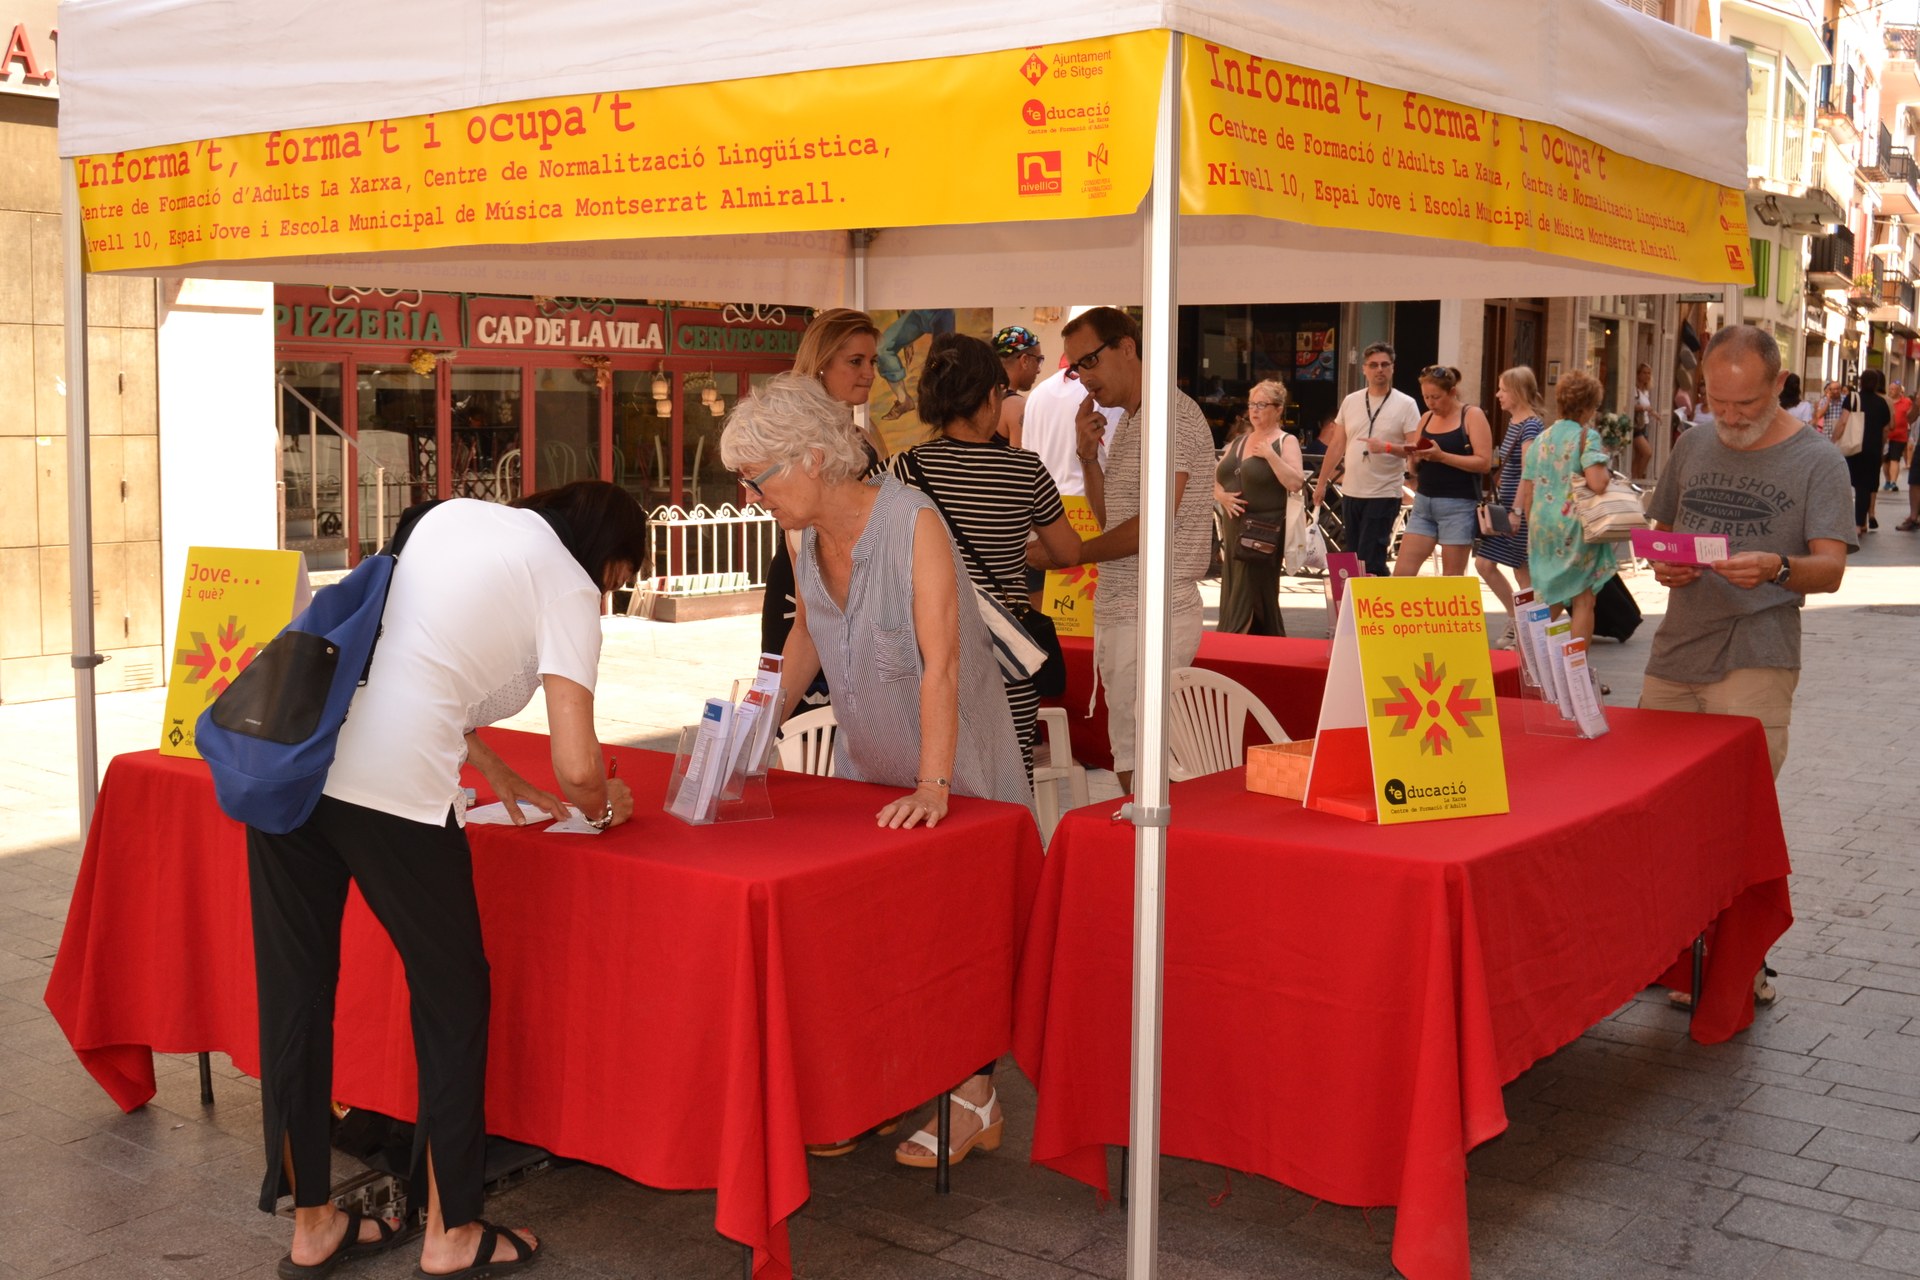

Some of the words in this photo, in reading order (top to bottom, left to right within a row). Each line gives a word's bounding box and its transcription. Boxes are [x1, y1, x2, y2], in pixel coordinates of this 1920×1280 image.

[1053, 50, 1112, 67] Ajuntament
[1053, 67, 1067, 79] de
[1070, 65, 1103, 79] Sitges
[1205, 44, 1382, 132] Informa't,
[1403, 92, 1499, 147] forma't
[1519, 118, 1528, 152] i
[1541, 133, 1606, 181] ocupa't
[79, 140, 238, 188] Informa't,
[265, 120, 400, 166] forma't
[423, 113, 442, 149] i
[467, 93, 635, 150] ocupa't
[1209, 112, 1267, 146] Centre
[1276, 127, 1295, 150] de
[1303, 132, 1374, 164] Formació
[1382, 146, 1445, 175] d'Adults
[1452, 159, 1469, 178] La
[1521, 171, 1553, 197] Centre
[1557, 182, 1568, 202] de
[81, 202, 123, 221] entre
[131, 198, 149, 215] de
[232, 181, 310, 204] d'Adults
[320, 180, 339, 197] La
[350, 175, 411, 194] Xarxa,
[424, 166, 487, 188] Centre
[501, 160, 528, 181] de
[539, 145, 705, 178] Normalització
[718, 134, 890, 169] Lingüística,
[134, 231, 158, 250] 10,
[169, 225, 202, 248] Espai
[210, 223, 250, 239] Jove
[260, 220, 269, 237] i
[280, 215, 339, 236] Escola
[349, 206, 444, 232] Municipal
[455, 204, 475, 223] de
[485, 200, 563, 221] Música
[575, 191, 707, 217] Montserrat
[720, 181, 846, 209] Almirall.
[1208, 162, 1274, 192] Nivell
[1280, 172, 1305, 203] 10,
[1314, 179, 1359, 209] Espai
[1367, 187, 1401, 211] Jove
[1409, 192, 1417, 212] i
[1424, 195, 1470, 219] Escola
[1538, 213, 1550, 232] de
[1554, 217, 1585, 241] Música
[1588, 226, 1637, 253] Montserrat
[274, 304, 445, 342] PIZZERIA
[478, 315, 533, 344] CAP
[534, 317, 566, 346] DE
[569, 319, 605, 348] LA
[606, 320, 663, 350] VILA
[678, 324, 803, 354] CERVECERI
[1736, 476, 1796, 513] SHORE
[1736, 495, 1759, 508] PIPE
[1703, 504, 1741, 518] HAWAII
[1710, 520, 1773, 537] BREAK
[189, 563, 261, 585] Jove...
[186, 586, 192, 599] i
[198, 586, 225, 601] què?
[1357, 596, 1395, 619] Més
[1401, 594, 1481, 618] estudis
[1361, 620, 1385, 636] més
[1393, 619, 1482, 638] oportunitats
